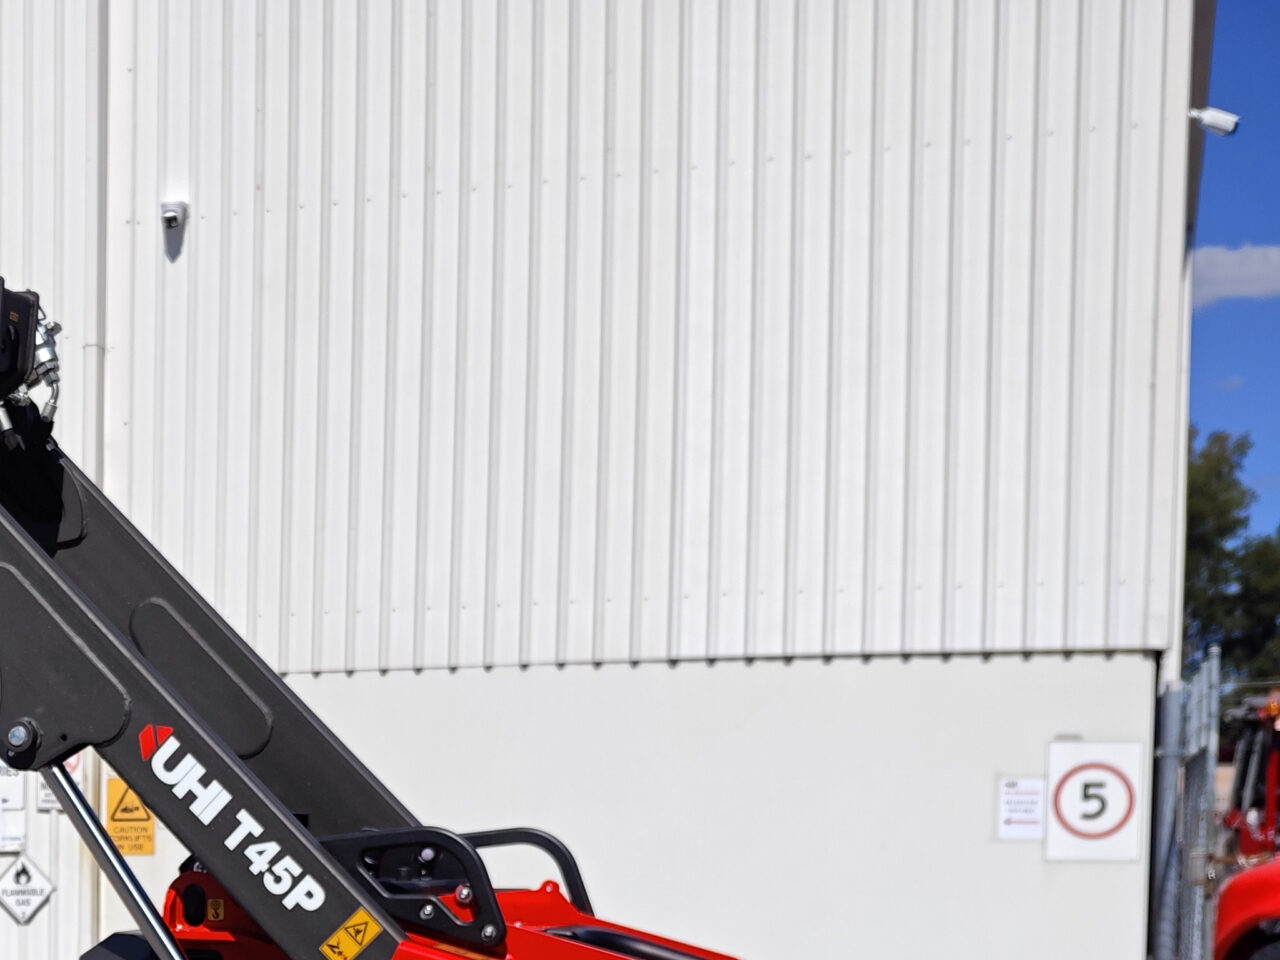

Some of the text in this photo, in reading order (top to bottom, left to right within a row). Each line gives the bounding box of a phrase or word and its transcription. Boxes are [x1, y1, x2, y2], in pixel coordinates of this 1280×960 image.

[1080, 782, 1108, 820] 5
[113, 826, 148, 834] CAUTION
[151, 736, 326, 912] UHI T45P
[1, 889, 45, 897] FLAMMABLE
